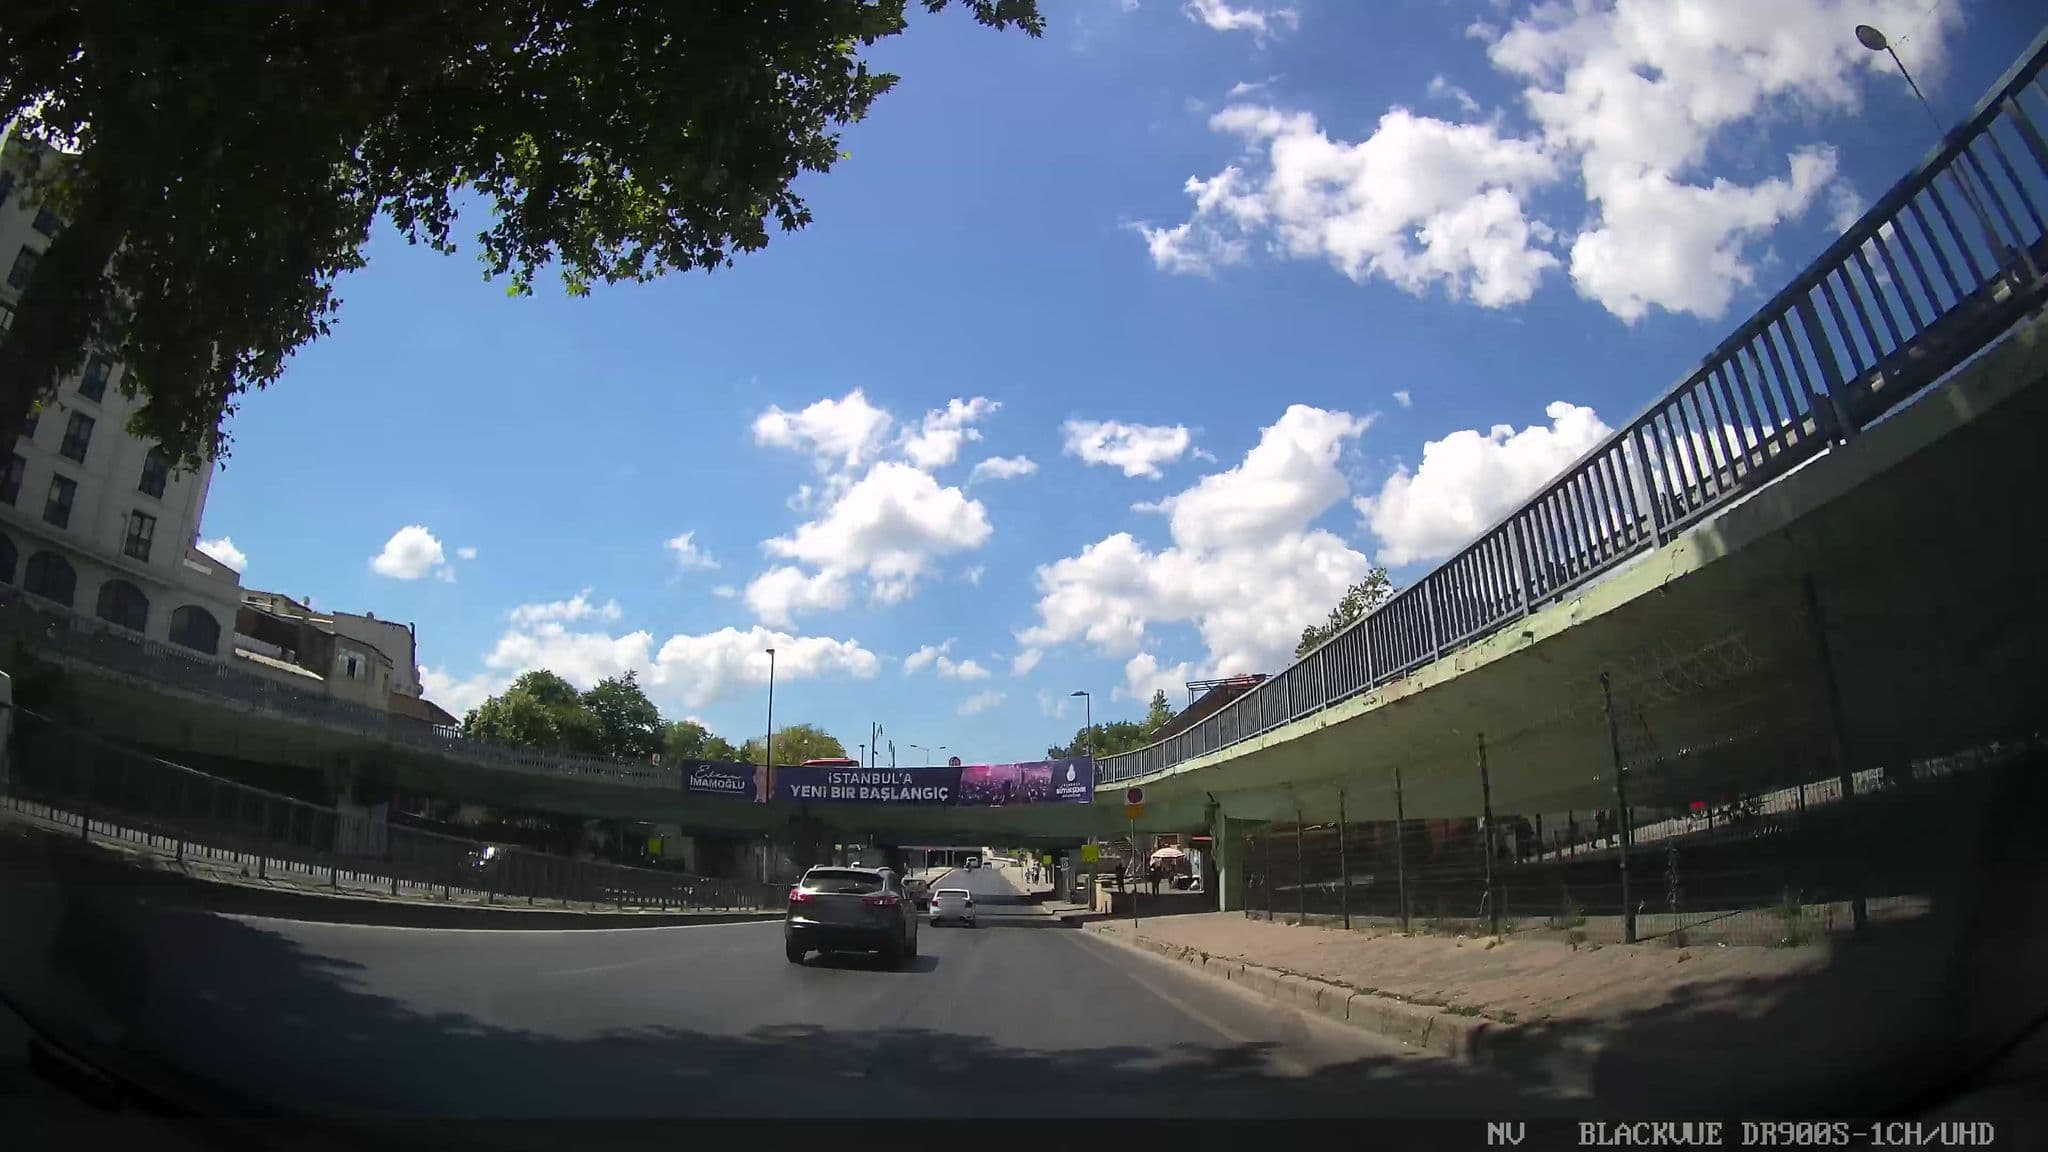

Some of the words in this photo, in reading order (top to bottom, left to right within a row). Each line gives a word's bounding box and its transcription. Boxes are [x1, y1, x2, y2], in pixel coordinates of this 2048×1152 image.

[828, 772, 912, 784] İSTANBUL'A
[791, 785, 827, 799] YENİ
[860, 786, 949, 801] BAŞLANGIÇ
